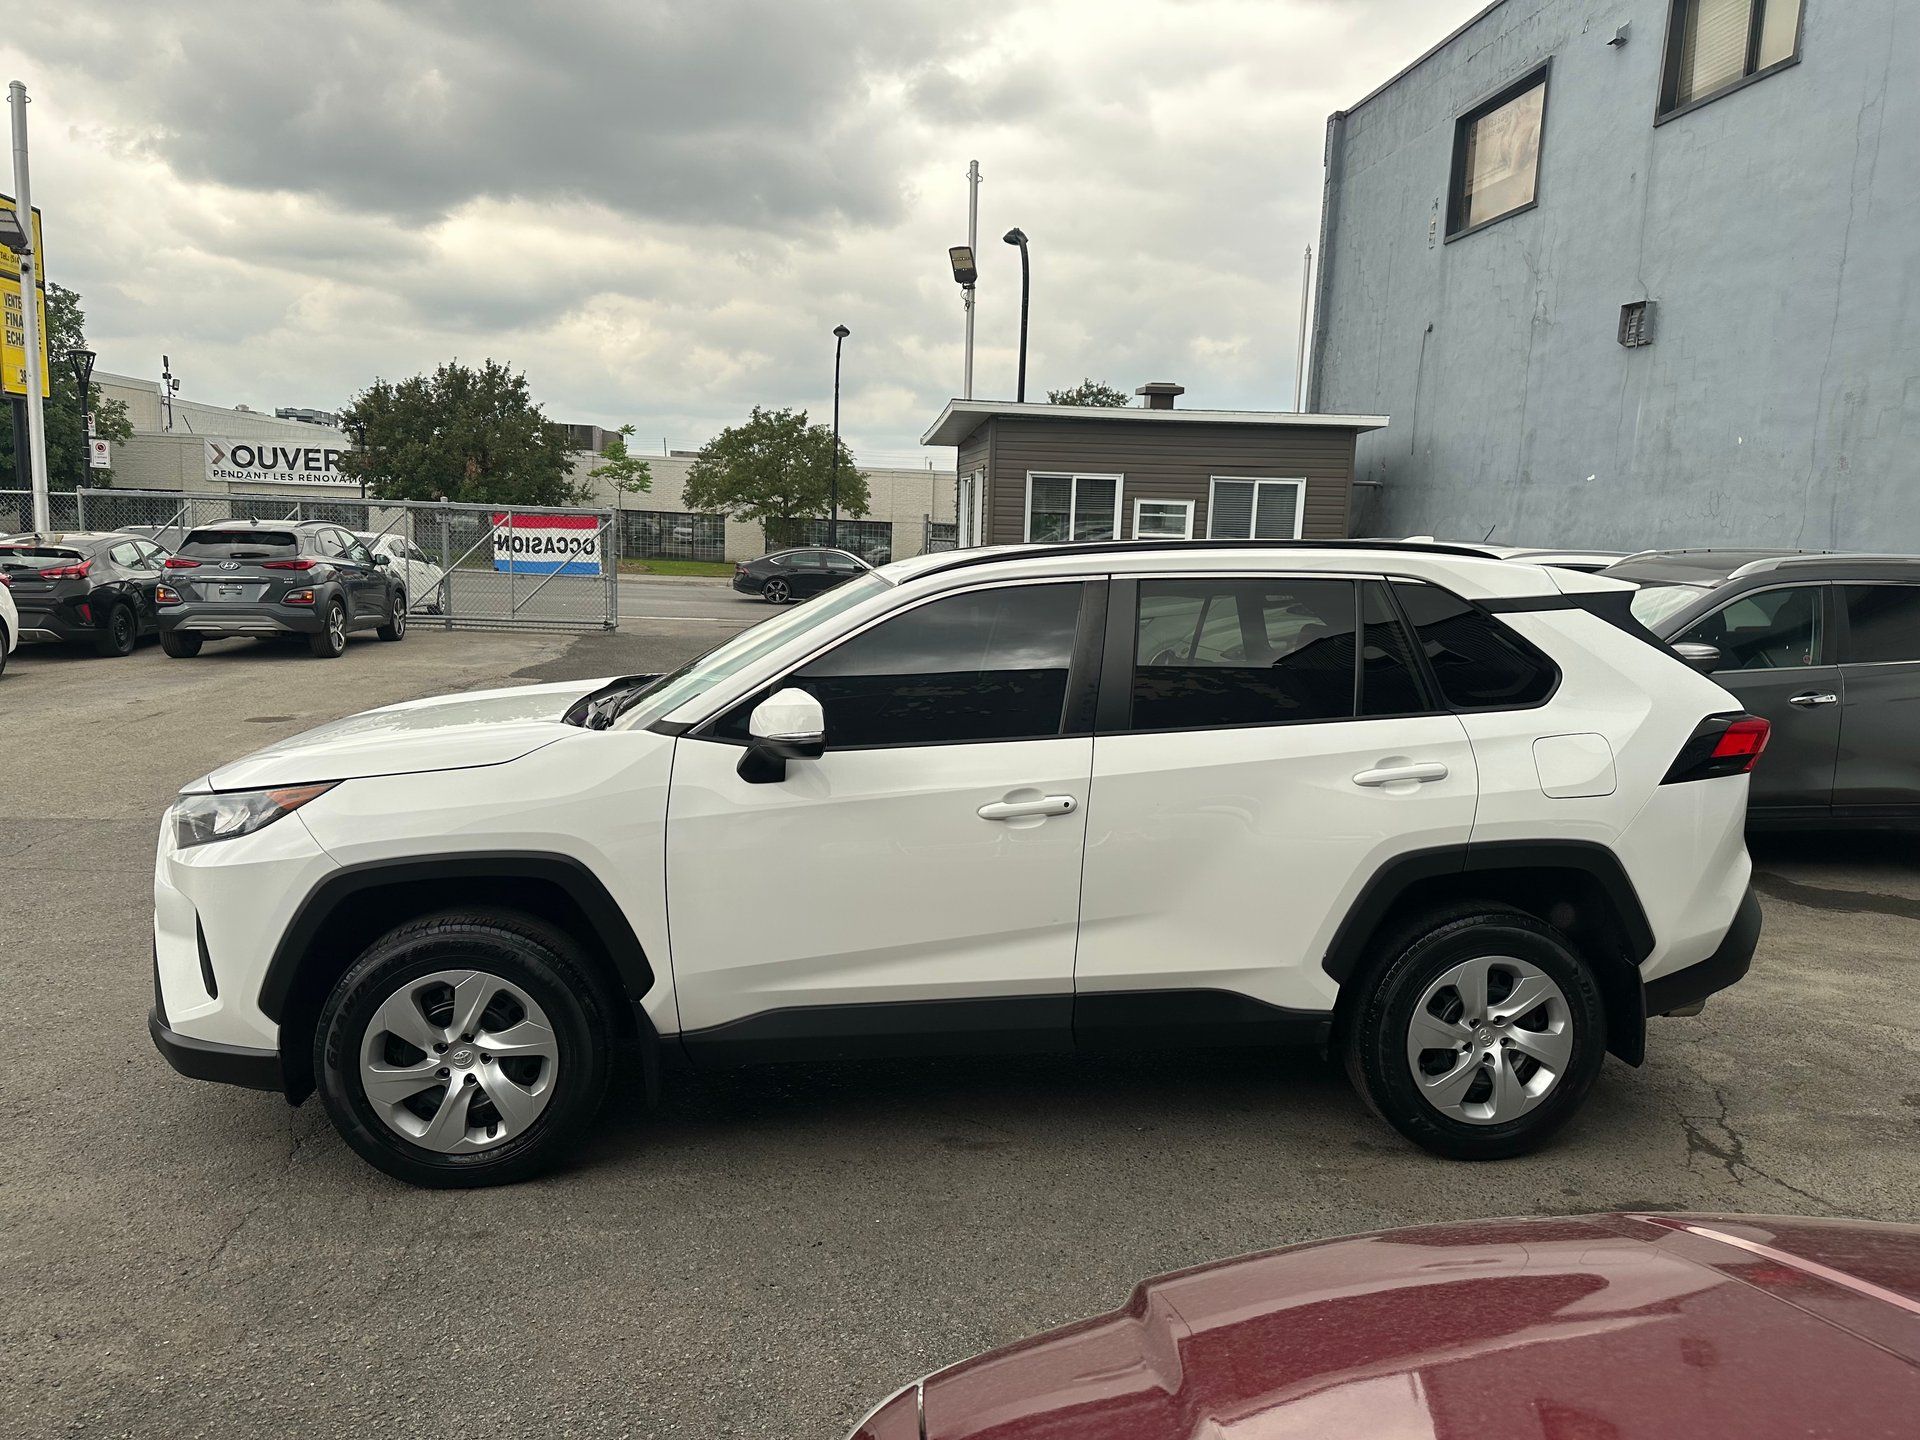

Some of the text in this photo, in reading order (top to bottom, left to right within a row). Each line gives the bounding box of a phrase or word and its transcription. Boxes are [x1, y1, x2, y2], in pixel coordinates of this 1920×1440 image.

[4, 293, 22, 309] VENTE
[230, 445, 352, 472] OUVER
[213, 469, 363, 484] PENDANT LES RÉNOVA
